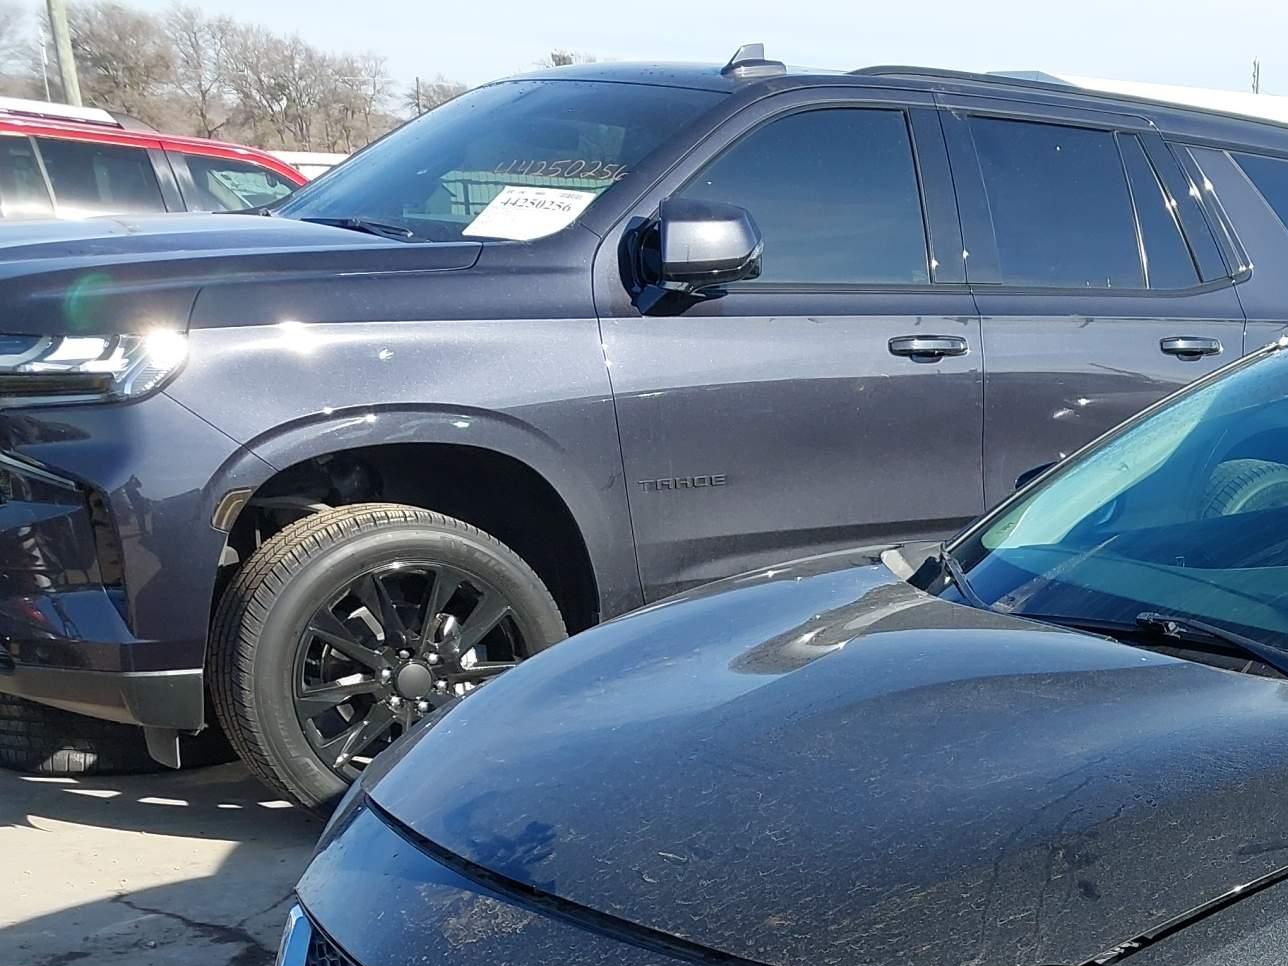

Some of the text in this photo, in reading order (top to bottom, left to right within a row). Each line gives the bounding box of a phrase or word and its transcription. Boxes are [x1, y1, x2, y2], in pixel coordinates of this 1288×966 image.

[494, 159, 630, 181] 44250256
[500, 197, 571, 213] 44250256
[638, 474, 727, 493] TAHOE
